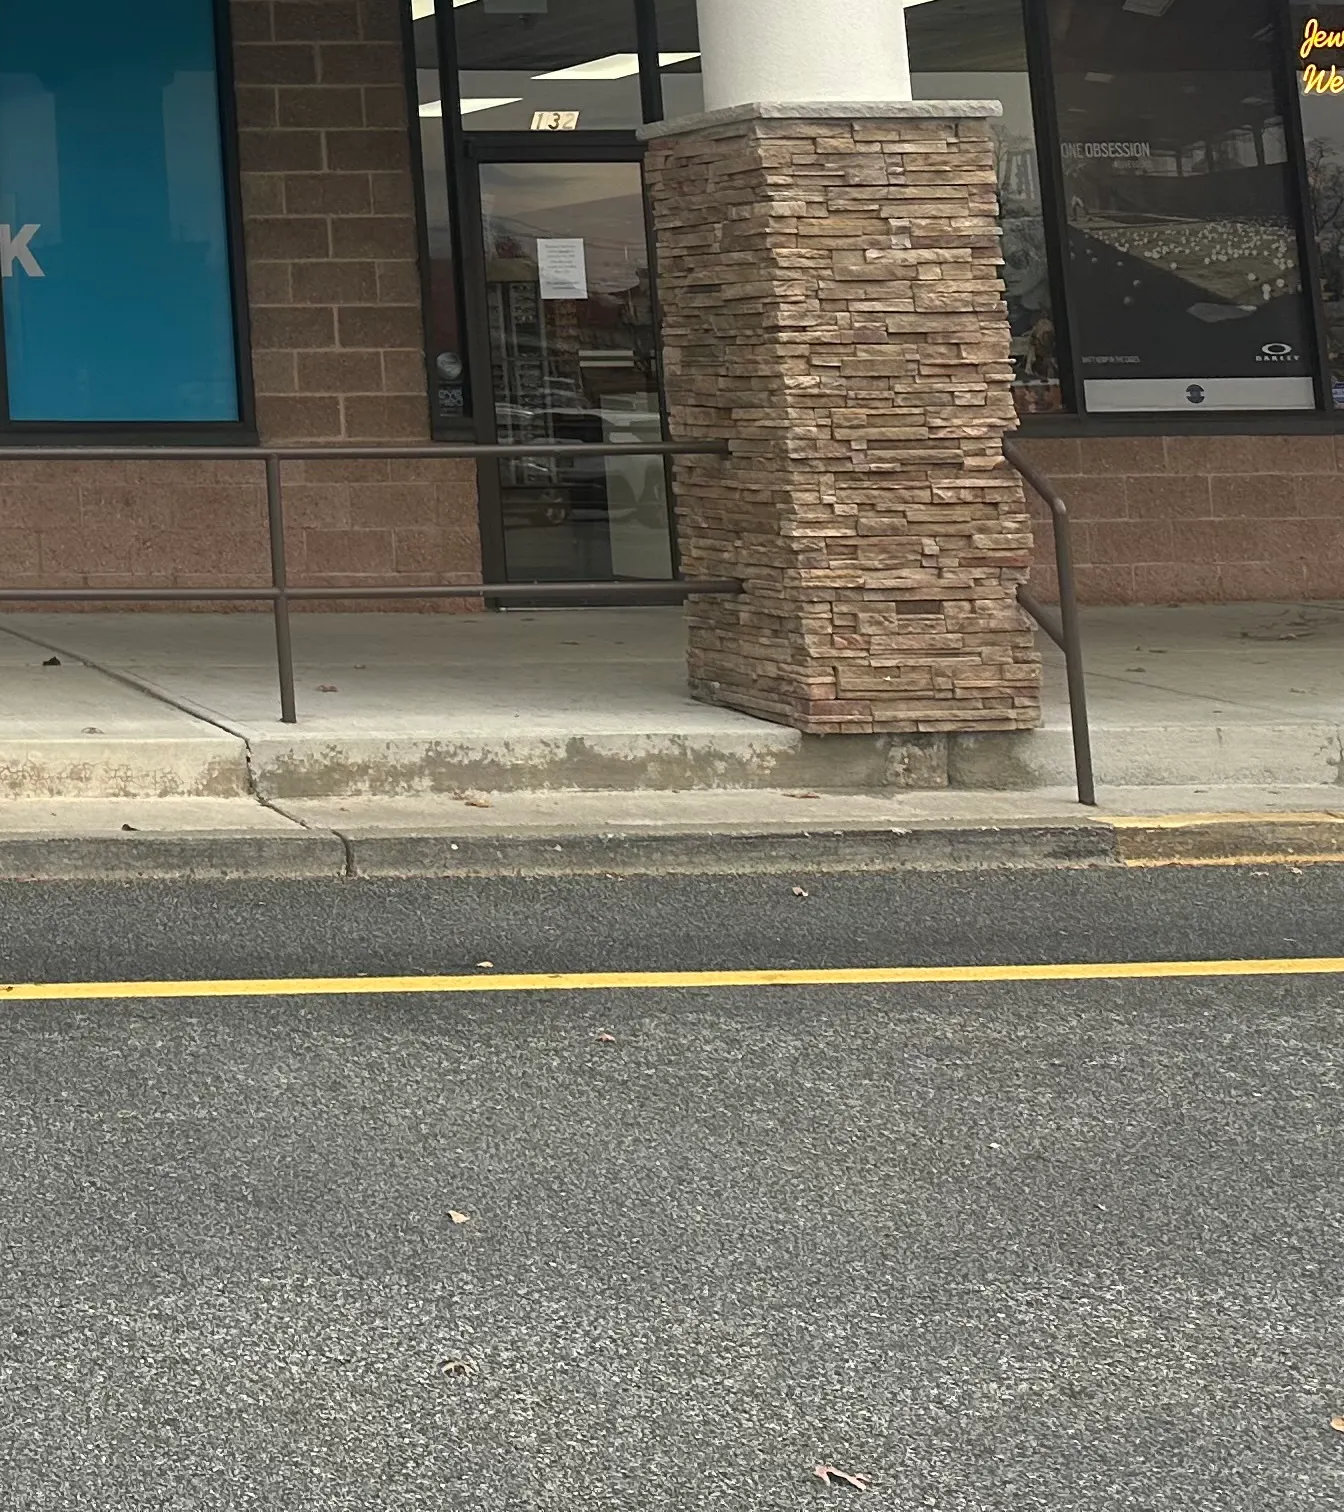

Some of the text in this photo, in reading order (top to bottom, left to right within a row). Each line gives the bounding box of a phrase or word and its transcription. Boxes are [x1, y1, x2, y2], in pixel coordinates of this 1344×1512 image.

[536, 112, 575, 129] 132
[1061, 142, 1151, 158] ONE OBSESSION
